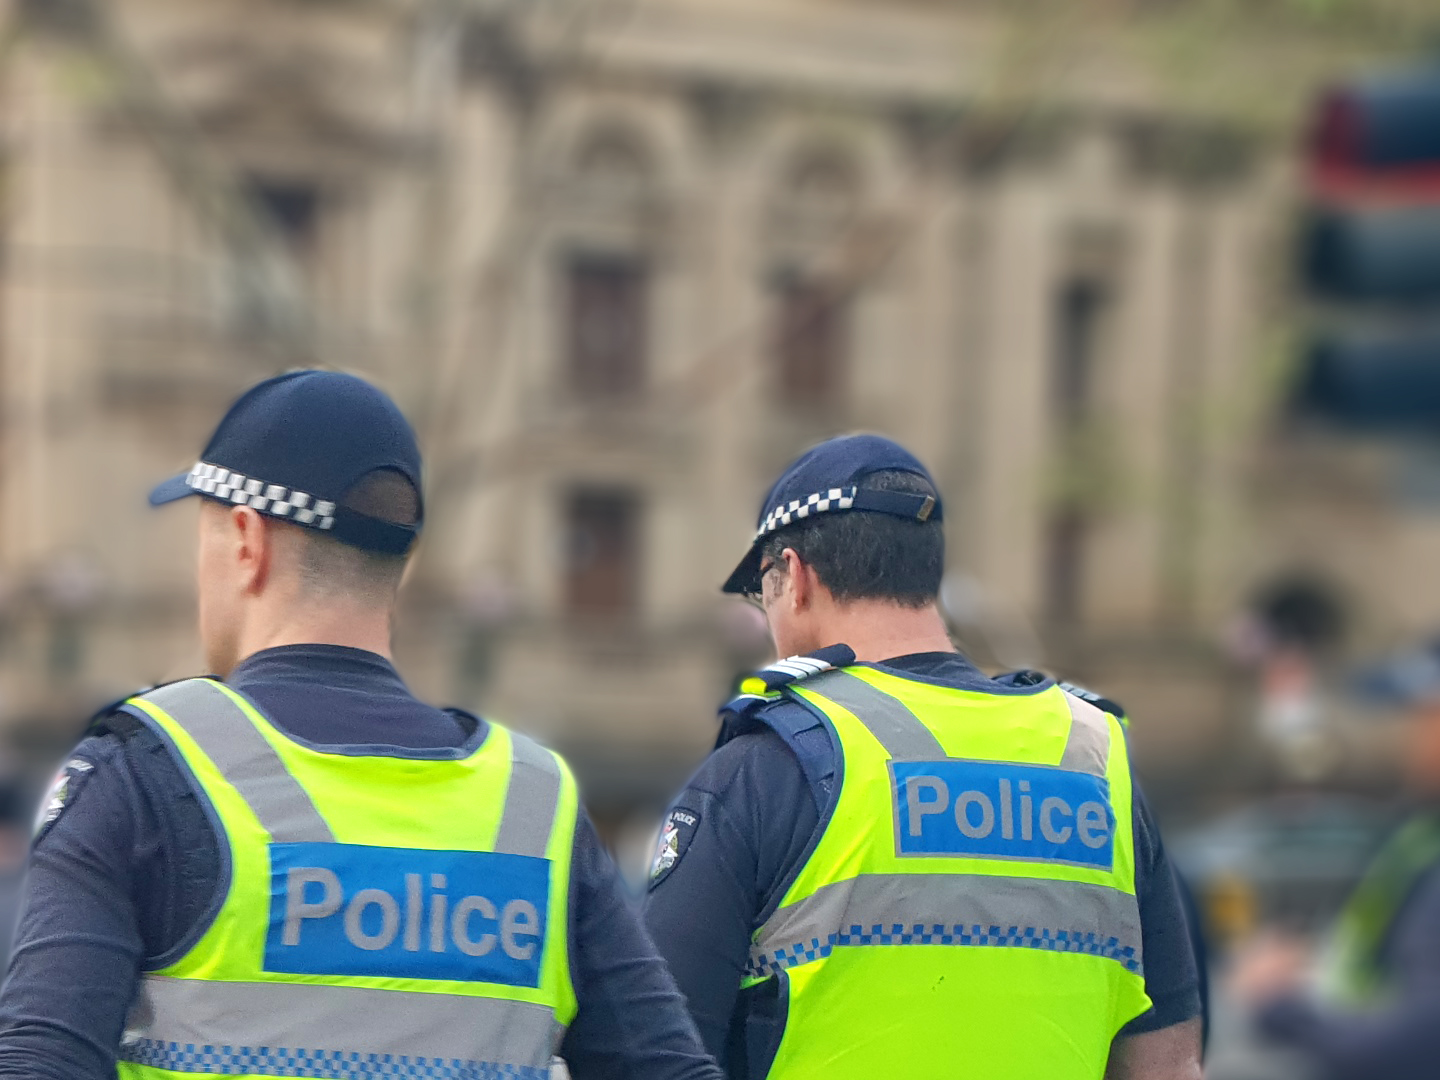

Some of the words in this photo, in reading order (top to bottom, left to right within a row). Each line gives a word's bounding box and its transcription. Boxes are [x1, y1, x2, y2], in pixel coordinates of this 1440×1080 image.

[673, 812, 696, 826] POLICE
[905, 774, 1109, 849] Police
[280, 866, 541, 960] Police
